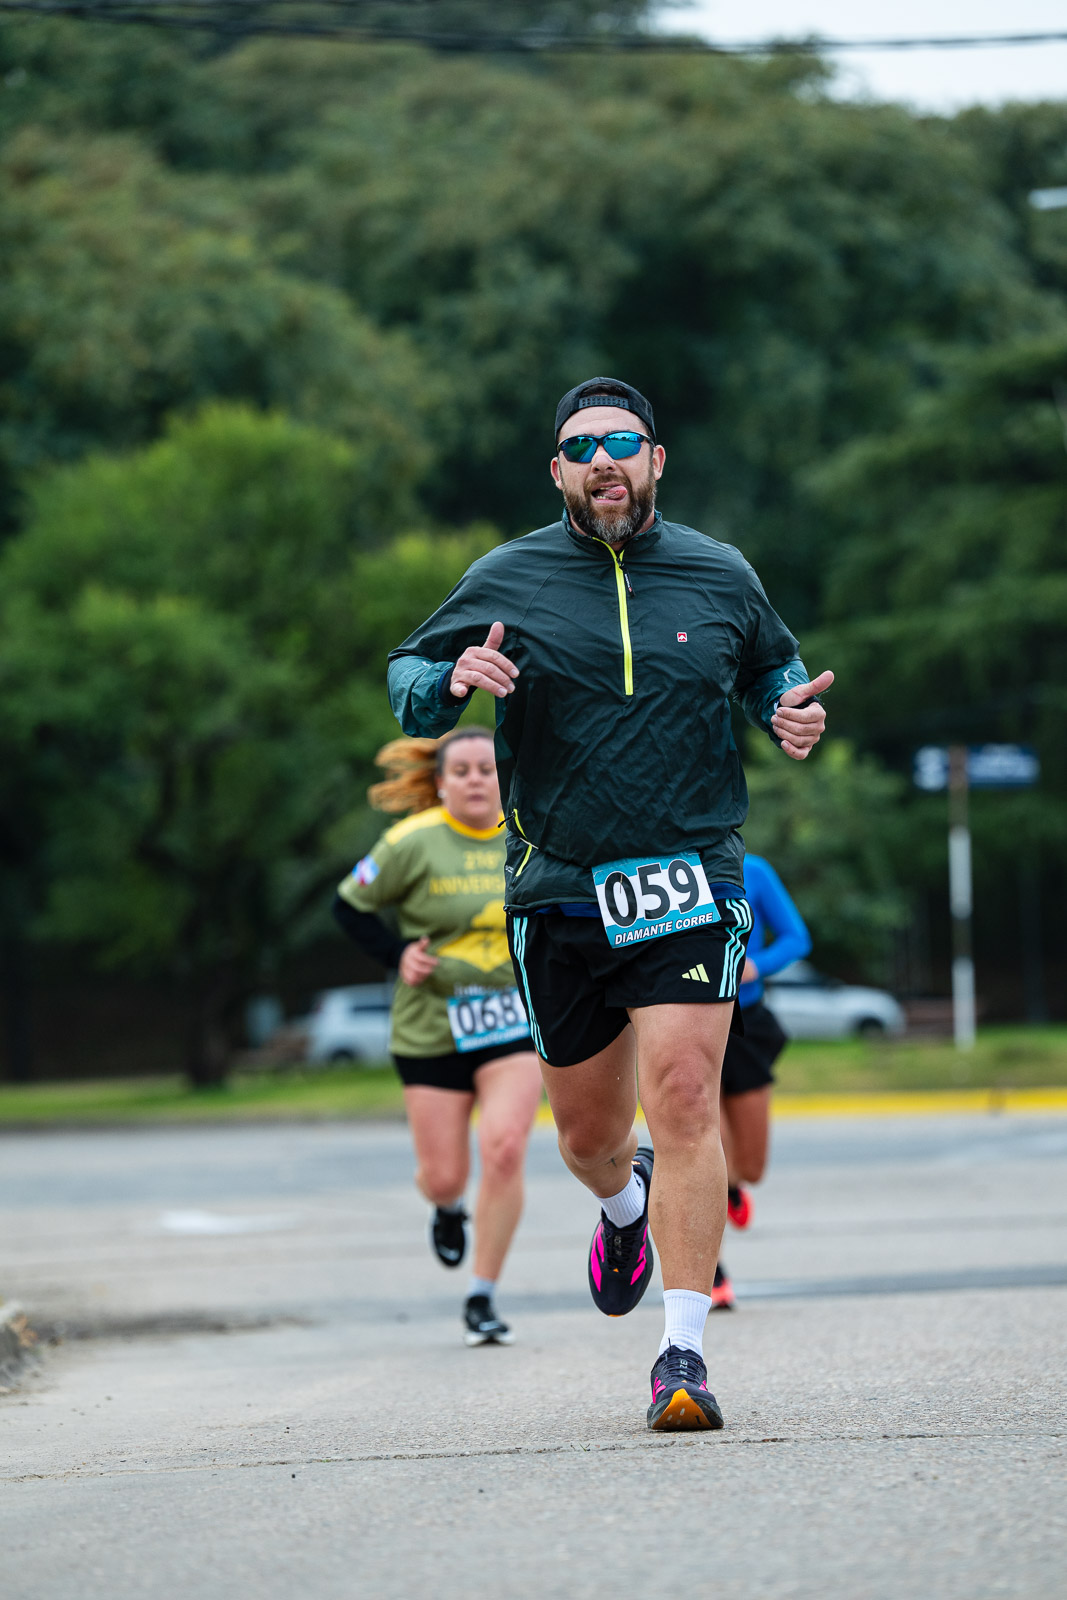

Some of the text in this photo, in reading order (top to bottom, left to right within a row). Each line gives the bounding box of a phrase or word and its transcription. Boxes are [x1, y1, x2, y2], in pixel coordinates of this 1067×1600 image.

[604, 859, 700, 928] 059
[615, 912, 713, 945] DIAMANTE CORRE
[457, 991, 518, 1035] 068
